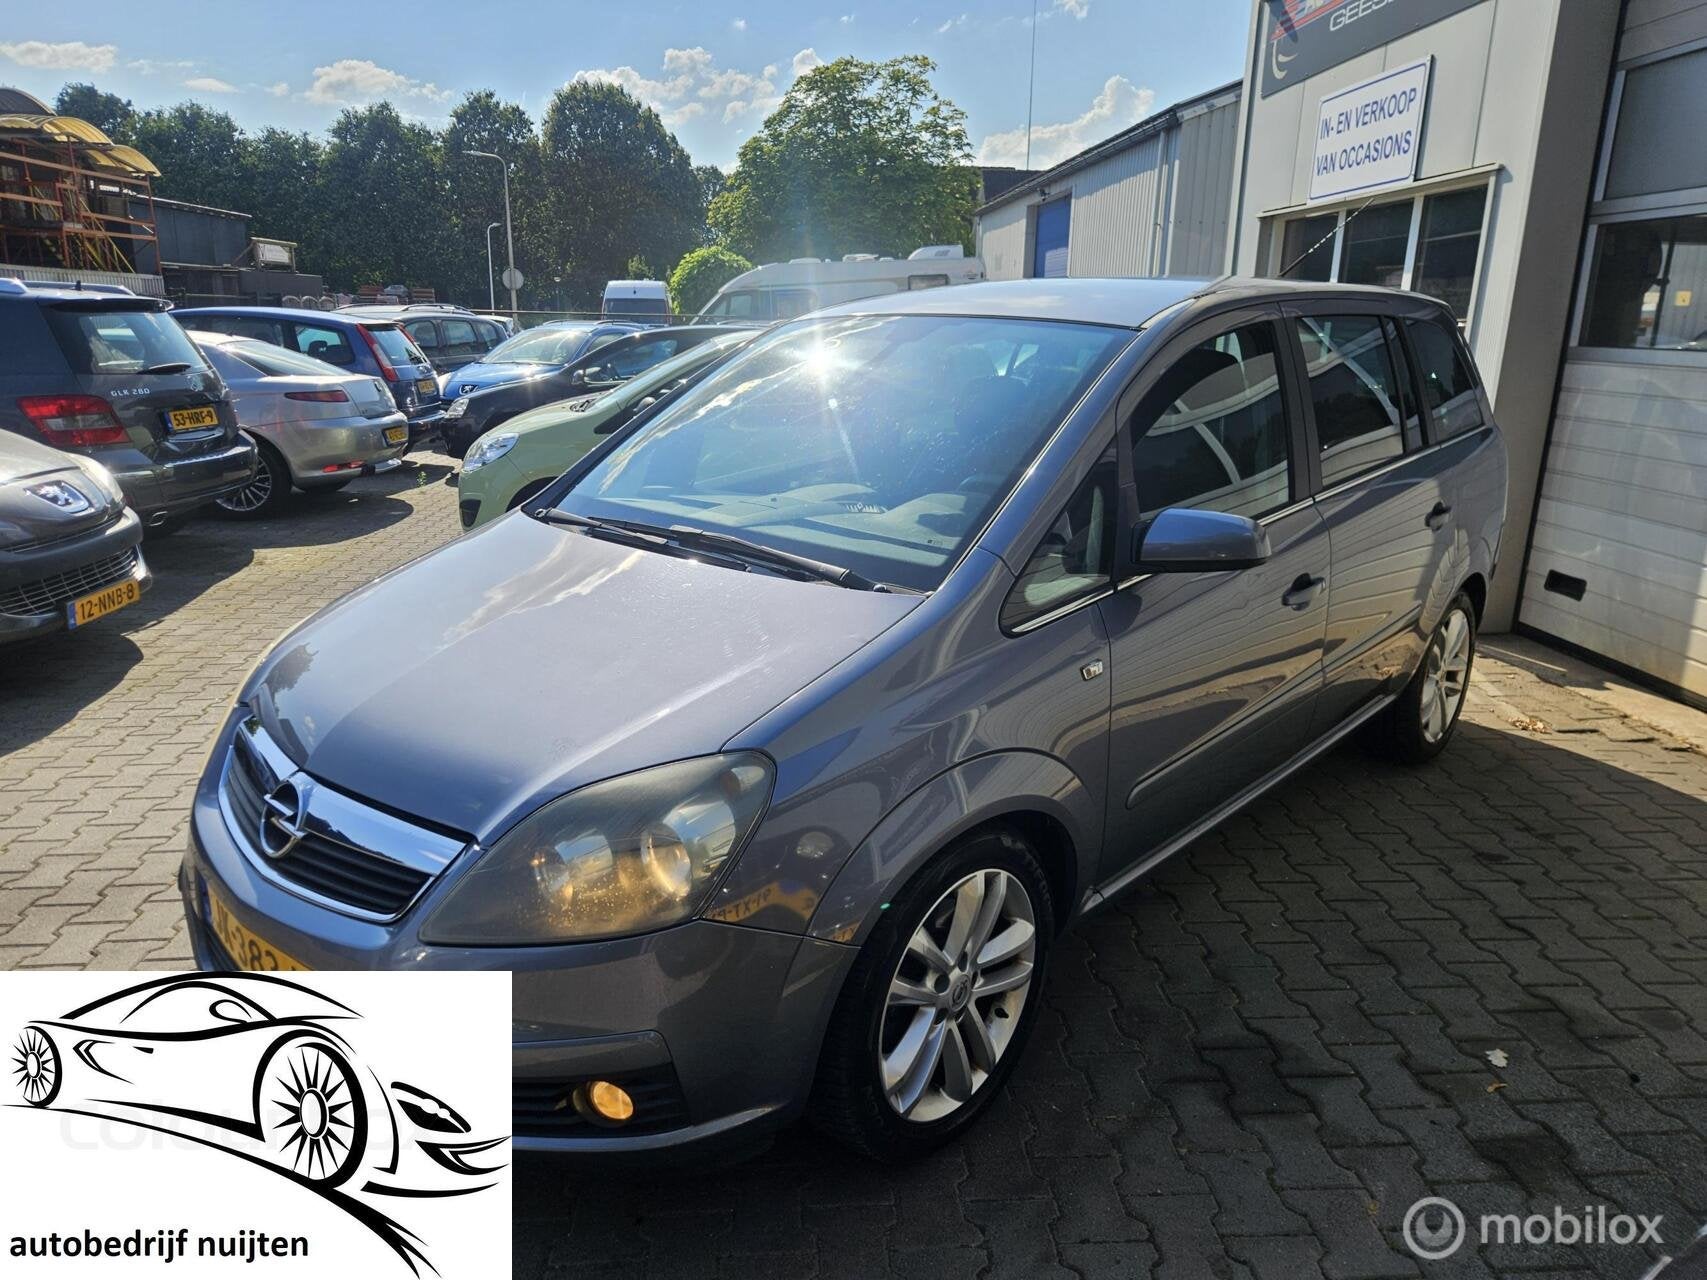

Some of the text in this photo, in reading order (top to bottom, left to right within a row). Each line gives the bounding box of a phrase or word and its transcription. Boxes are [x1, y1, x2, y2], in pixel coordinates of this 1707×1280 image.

[1320, 87, 1417, 140] IN- EN VERKOOP
[1316, 130, 1412, 177] VAN OCCASIONS
[110, 387, 151, 397] GLK 280
[173, 409, 214, 427] 53-HRF-9
[79, 582, 135, 621] 12-NNB-8
